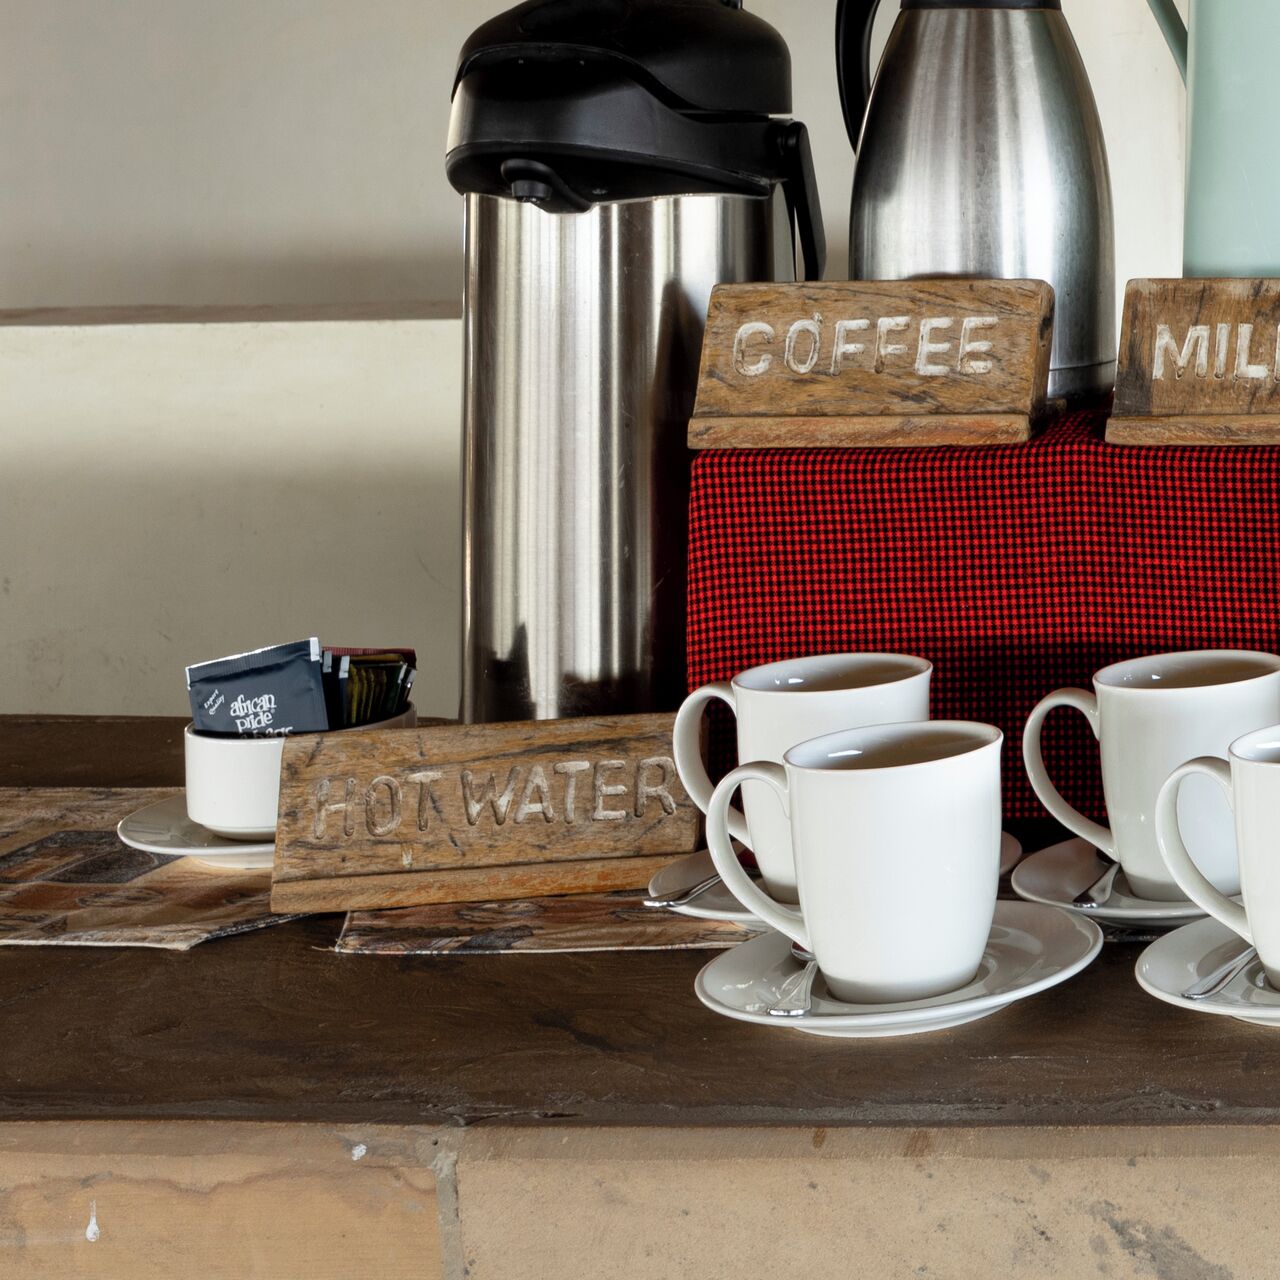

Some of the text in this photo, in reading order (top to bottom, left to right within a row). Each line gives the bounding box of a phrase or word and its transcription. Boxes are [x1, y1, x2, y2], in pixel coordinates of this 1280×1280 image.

[732, 314, 999, 378] COFFEE
[230, 693, 277, 717] african
[235, 711, 274, 734] pride
[313, 755, 680, 840] HOT WATER
